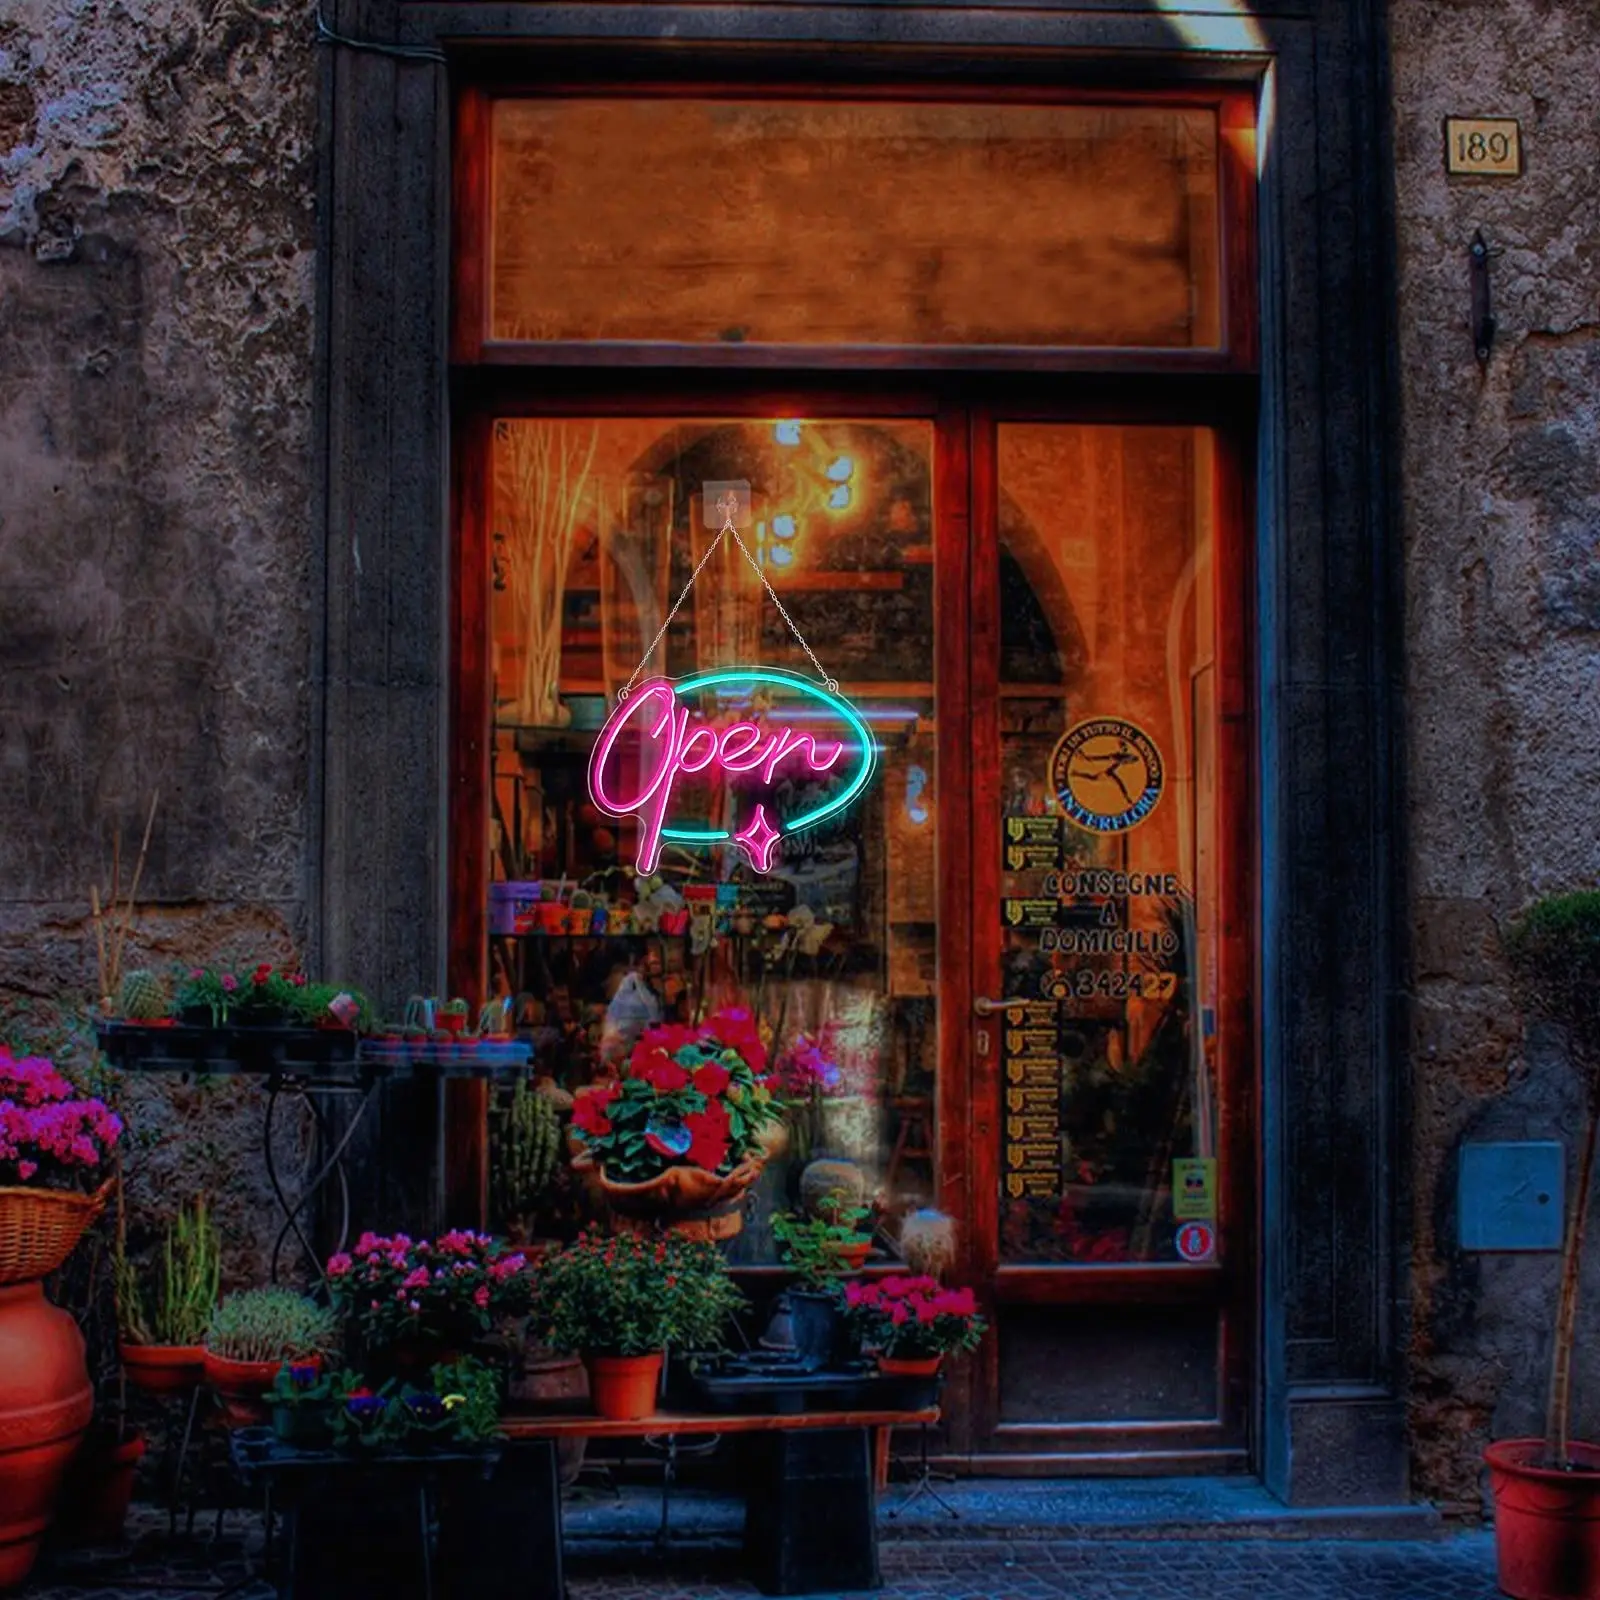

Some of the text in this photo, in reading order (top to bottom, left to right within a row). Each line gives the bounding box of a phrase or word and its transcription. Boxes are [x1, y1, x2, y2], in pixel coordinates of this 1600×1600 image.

[1458, 131, 1508, 163] 189
[594, 682, 843, 871] Open
[1057, 787, 1160, 831] INTERFLORA
[1043, 870, 1178, 897] CONSEGNE
[1099, 899, 1118, 926] A
[1040, 928, 1180, 957] DOMICILIO
[1075, 969, 1178, 1000] 342427
